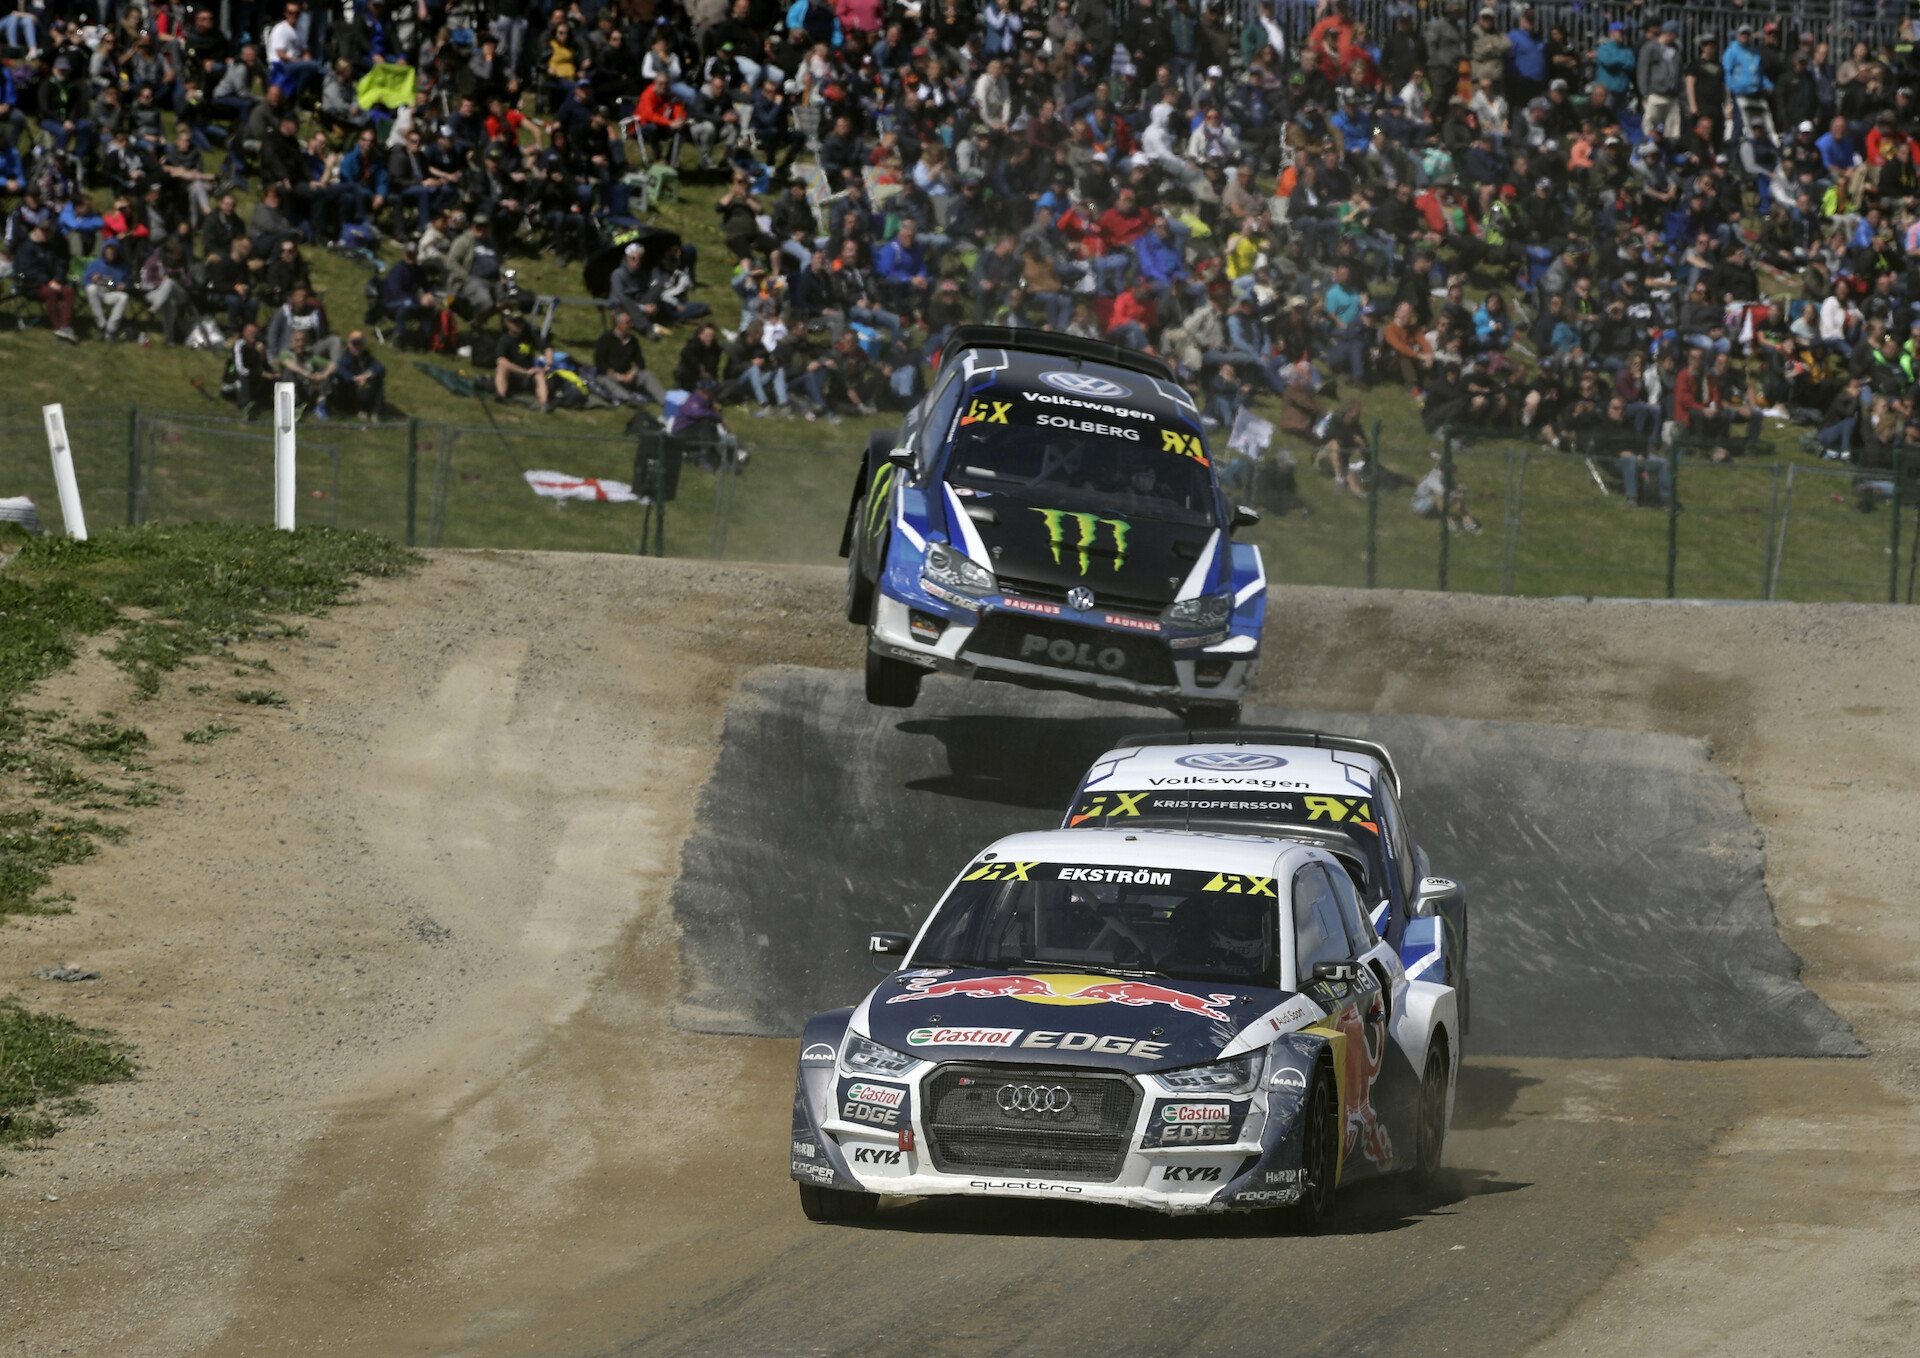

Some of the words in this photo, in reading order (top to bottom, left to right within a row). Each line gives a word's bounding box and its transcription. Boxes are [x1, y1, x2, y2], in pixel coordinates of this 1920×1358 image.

[1022, 391, 1156, 422] Volkswagen
[1036, 413, 1141, 441] SOLBERG
[1003, 599, 1060, 614] BAUHAUS
[1105, 615, 1161, 632] BAUHAUS
[1021, 633, 1126, 671] POLO
[1148, 776, 1310, 789] Volkswagen
[1153, 799, 1293, 811] KRISTOFFERSSON
[1057, 867, 1172, 886] EKSTRÖM
[932, 1028, 1012, 1045] Castrol
[1019, 1030, 1172, 1061] EDGE
[804, 1053, 833, 1061] MAN
[1273, 1077, 1304, 1088] MAN
[859, 1086, 901, 1106] Castrol
[842, 1102, 901, 1127] EDGE
[1178, 1105, 1227, 1121] Castrol
[1161, 1124, 1233, 1142] EDGE
[855, 1148, 901, 1165] KYB
[792, 1161, 835, 1179] COOPER
[1162, 1165, 1222, 1181] KYB
[1265, 1170, 1285, 1184] H&R
[811, 1174, 833, 1185] TIRES
[970, 1180, 1083, 1193] quattro
